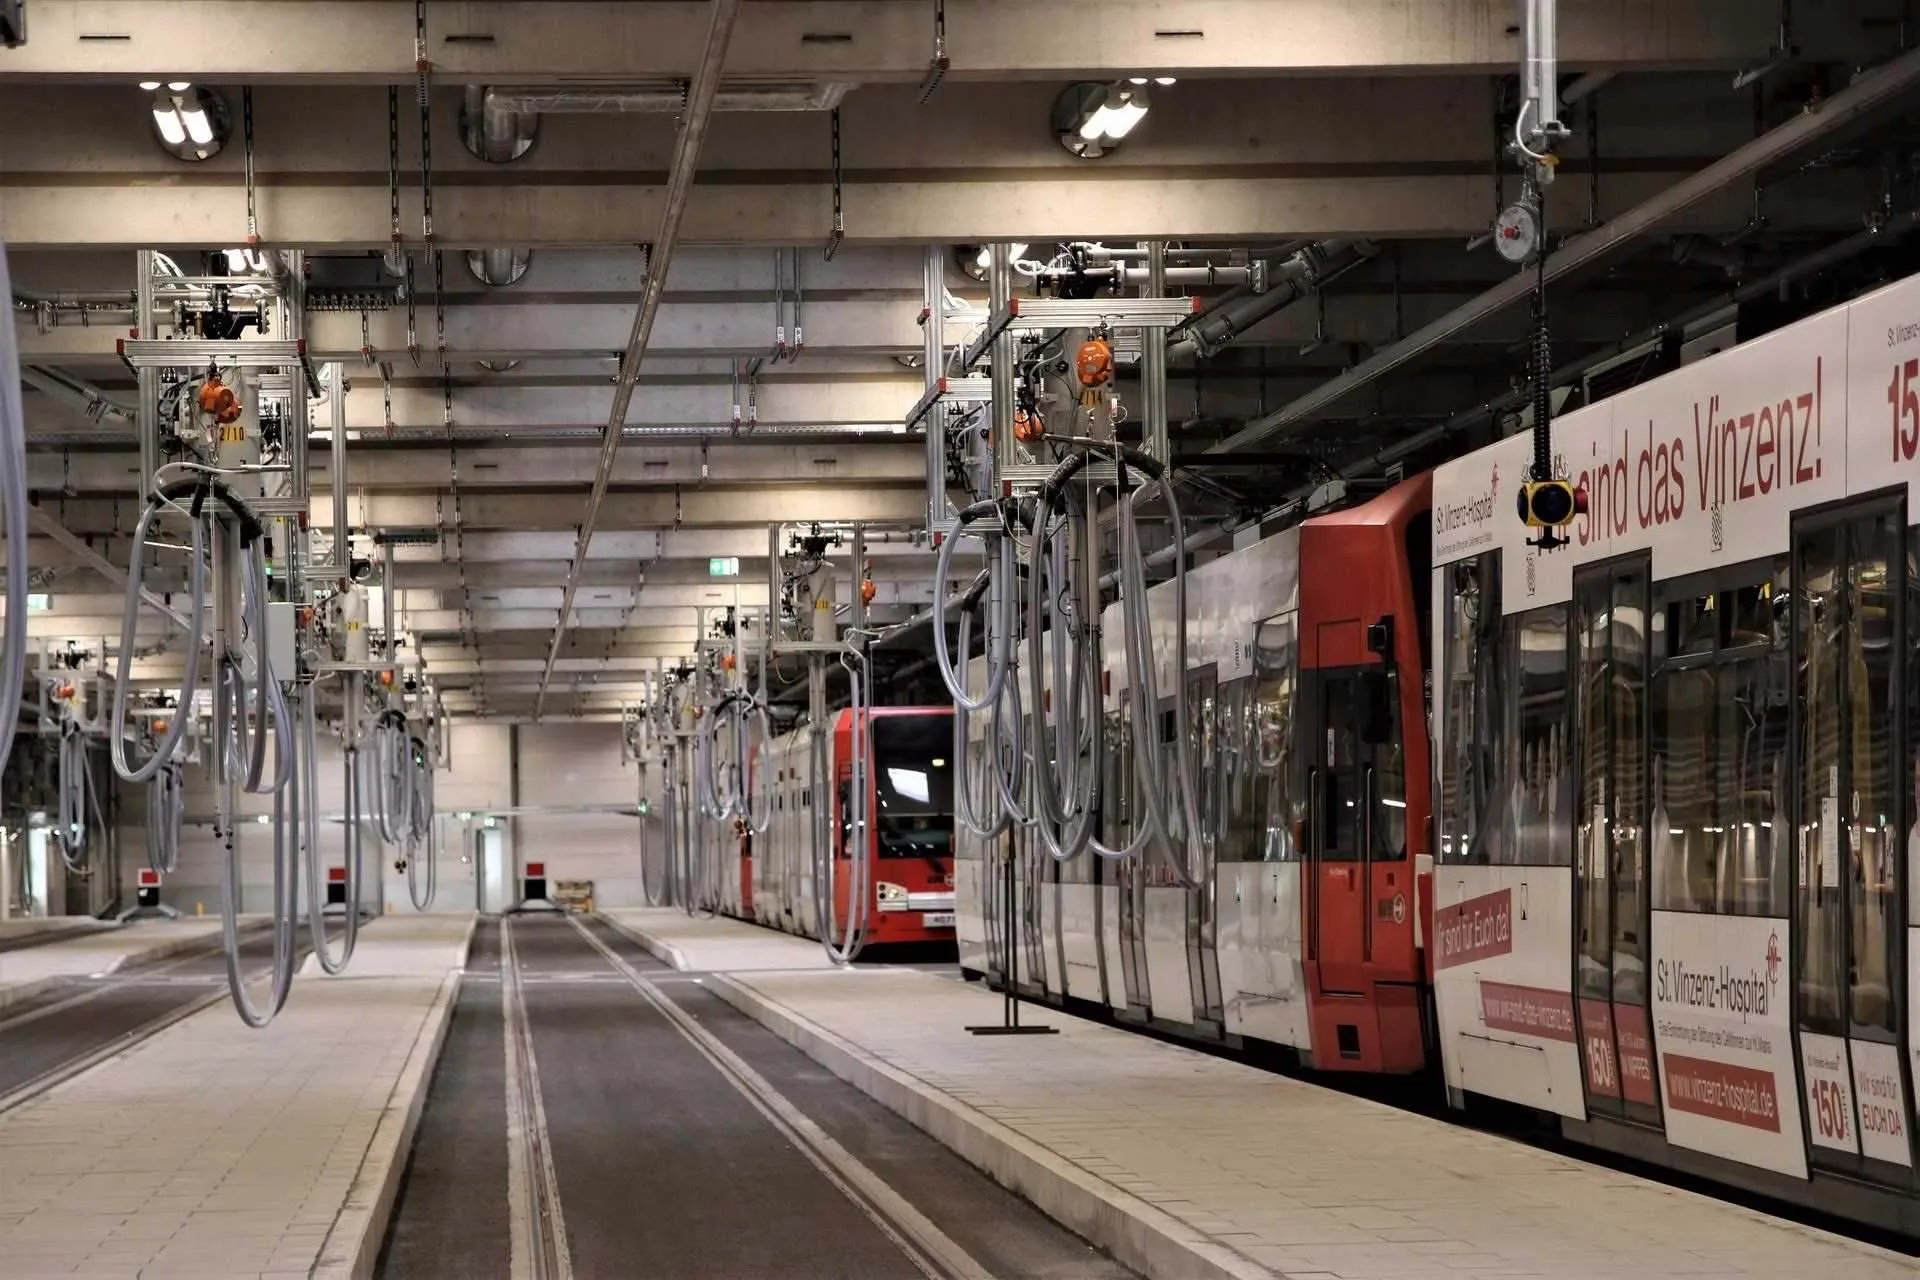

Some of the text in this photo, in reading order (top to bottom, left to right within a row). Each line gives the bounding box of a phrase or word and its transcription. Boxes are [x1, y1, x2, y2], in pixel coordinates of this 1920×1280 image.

[1578, 429, 1628, 546] sind
[1638, 420, 1684, 529] das
[1694, 356, 1821, 510] Vinzenz!
[1474, 906, 1495, 948] Euch
[1657, 958, 1768, 1024] St. Vinzenz-Hospital
[1588, 1036, 1610, 1088] 150
[1668, 1071, 1775, 1119] www.vinzenz-hospital.de
[1812, 1078, 1845, 1140] 150
[1862, 1103, 1889, 1133] EUCH
[1888, 1108, 1903, 1137] DA
